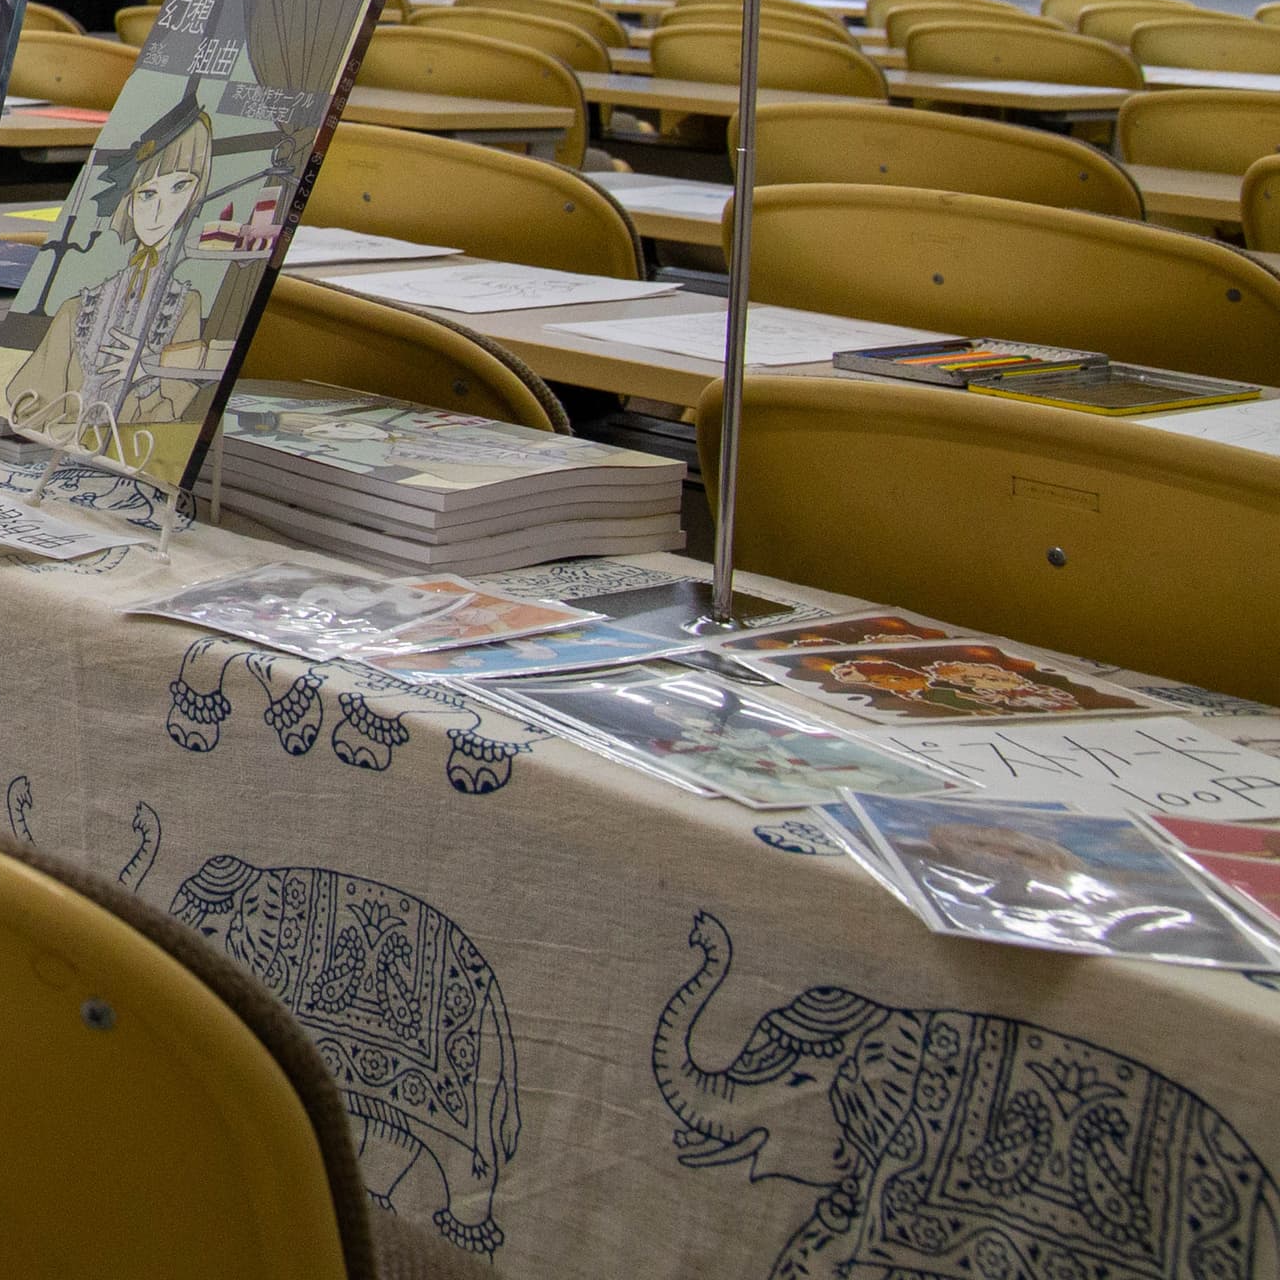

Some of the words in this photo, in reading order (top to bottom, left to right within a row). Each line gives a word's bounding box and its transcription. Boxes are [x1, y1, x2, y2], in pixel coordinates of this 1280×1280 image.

[186, 37, 240, 76] 組曲
[888, 728, 1242, 779] ポストカード
